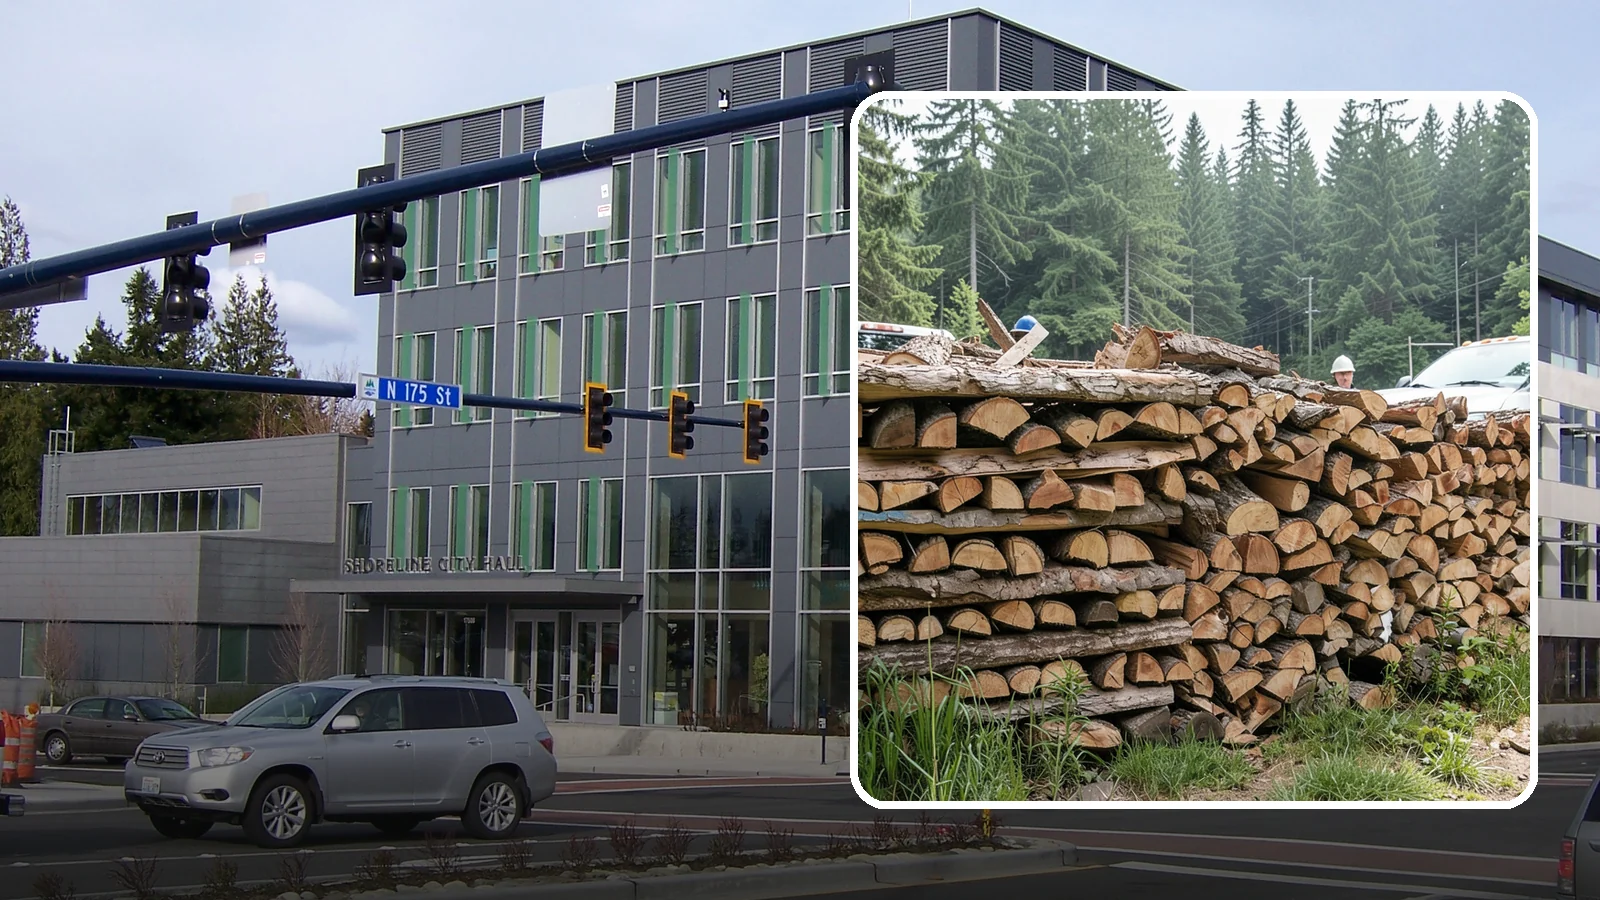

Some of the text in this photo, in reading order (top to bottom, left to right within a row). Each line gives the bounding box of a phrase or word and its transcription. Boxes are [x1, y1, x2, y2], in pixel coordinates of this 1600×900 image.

[387, 380, 451, 406] N 175 St
[344, 555, 525, 574] SHORELINE CITY HALL
